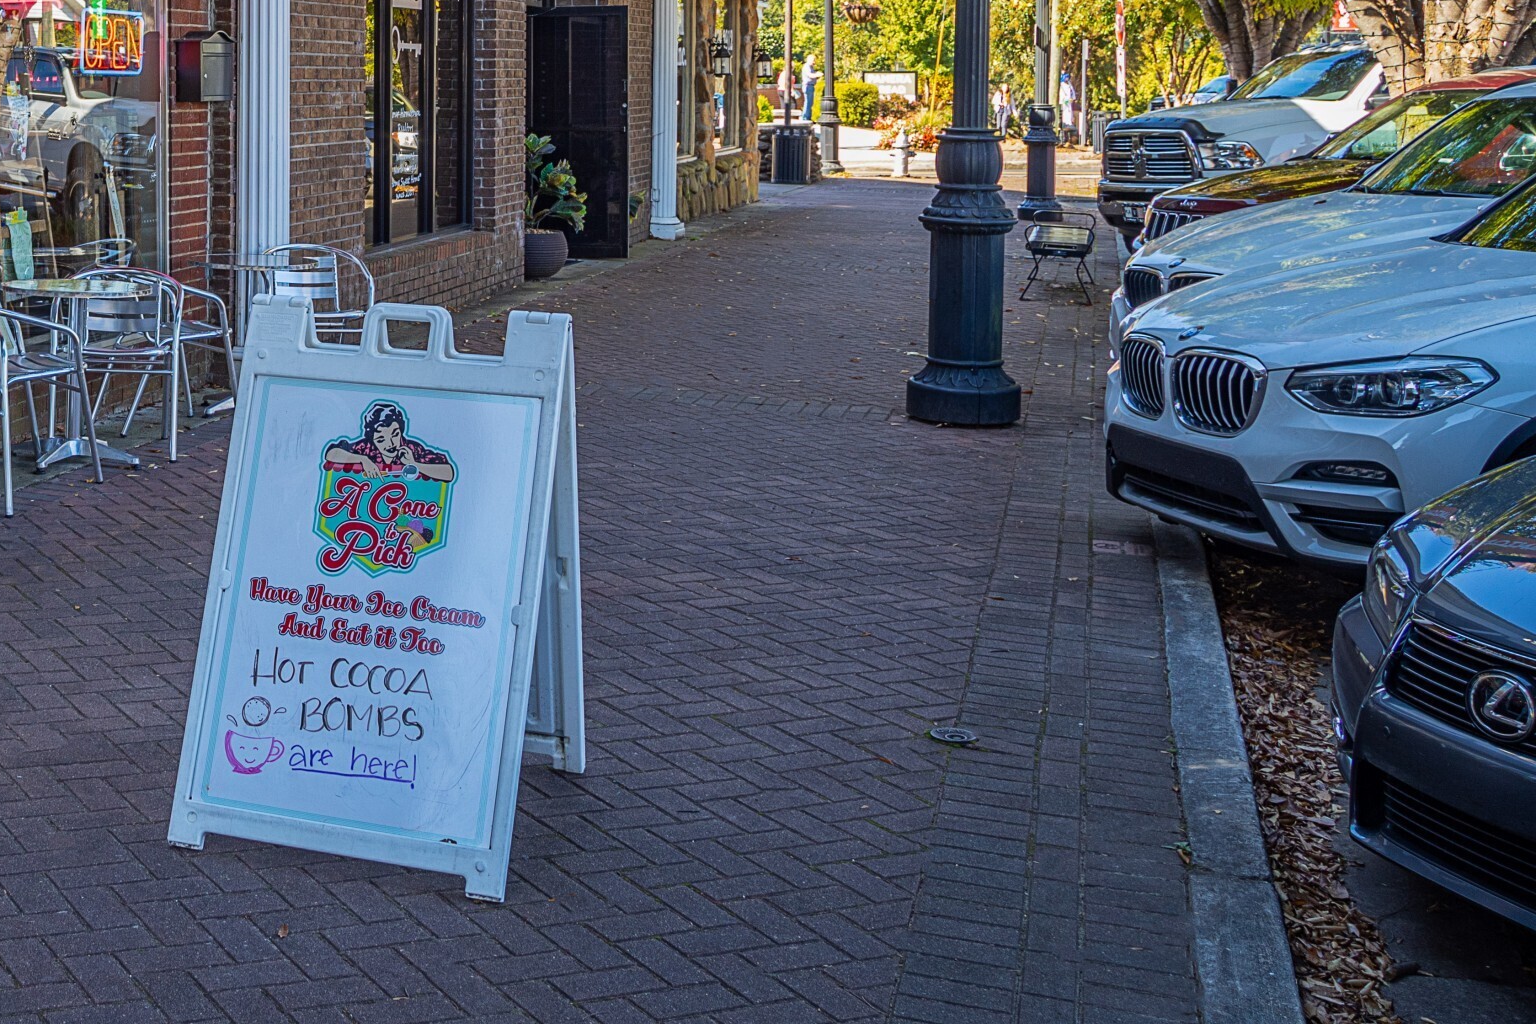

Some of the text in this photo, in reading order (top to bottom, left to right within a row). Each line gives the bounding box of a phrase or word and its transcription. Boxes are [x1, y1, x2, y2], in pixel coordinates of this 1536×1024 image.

[84, 13, 142, 70] OPEN
[319, 477, 441, 523] A Cone
[320, 521, 416, 571] Pick
[384, 522, 398, 541] to
[250, 577, 486, 628] Have Your Ice Cream
[279, 613, 445, 655] And Eat it Too
[330, 657, 432, 700] COCOA
[300, 696, 425, 742] BOMBS
[289, 745, 417, 790] are here!
